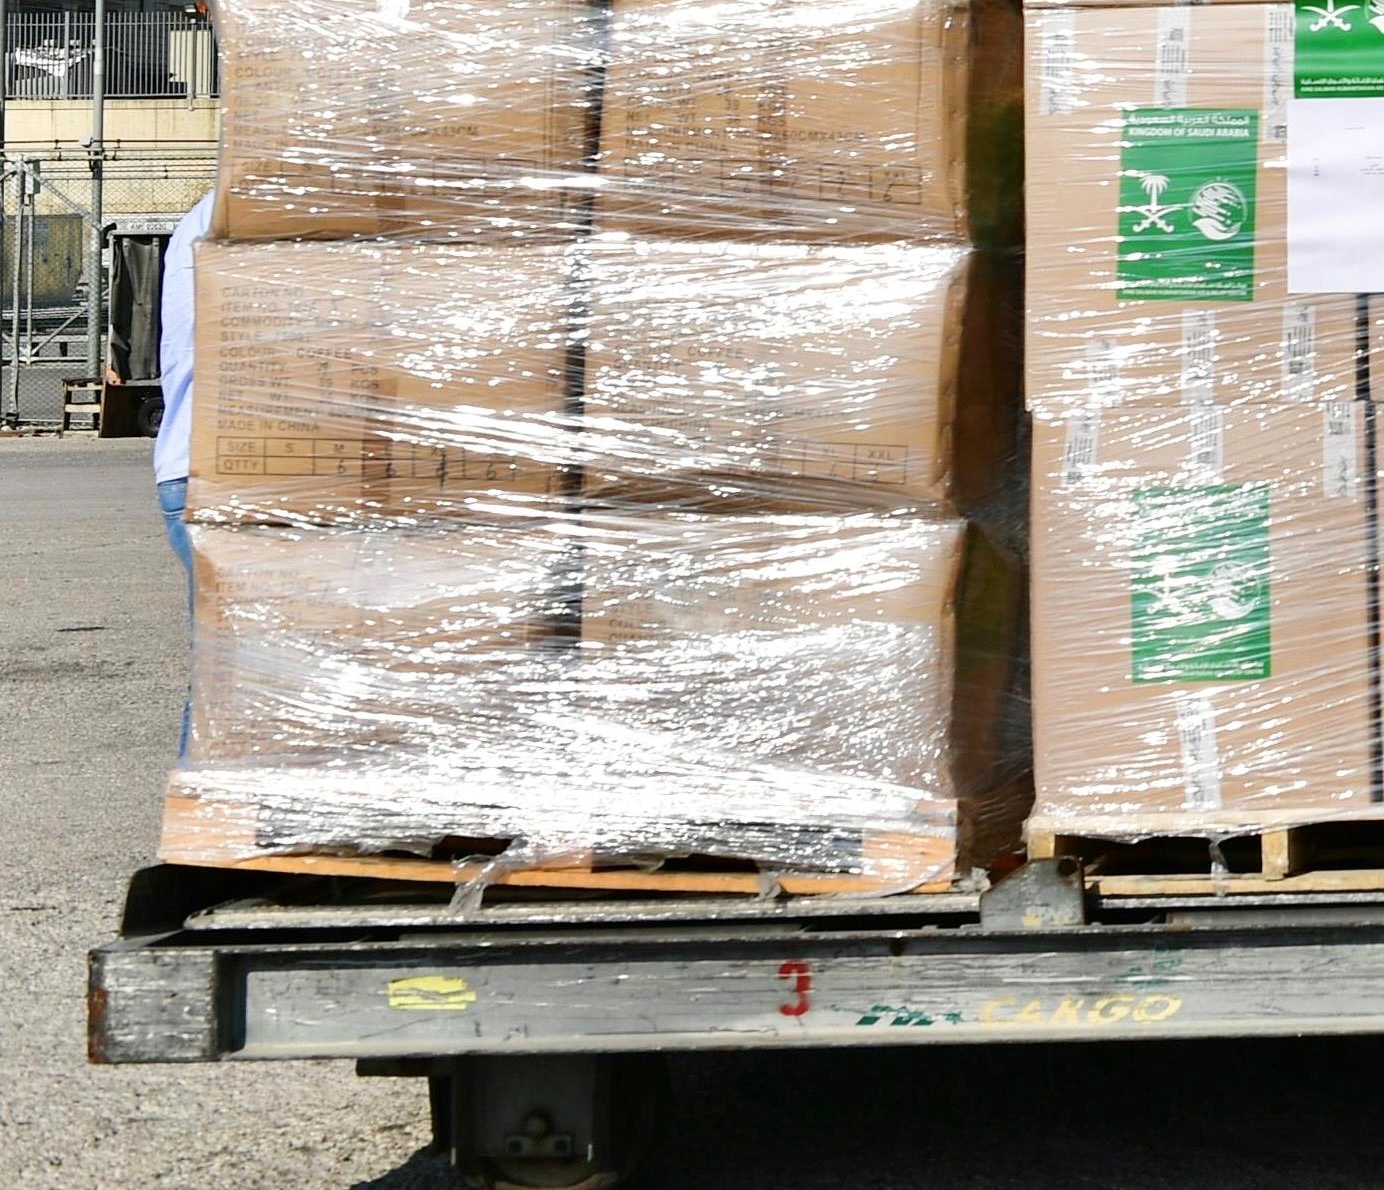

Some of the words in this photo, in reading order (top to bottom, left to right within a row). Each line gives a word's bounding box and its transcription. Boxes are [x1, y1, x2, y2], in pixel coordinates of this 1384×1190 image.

[1129, 128, 1173, 138] KINGDOM
[1174, 128, 1187, 137] OF
[1186, 128, 1215, 137] SAUDI
[1215, 128, 1250, 137] ARABIA
[217, 421, 256, 432] MADE
[261, 422, 272, 432] IN
[277, 422, 320, 433] CHINA
[227, 441, 256, 453] SIZE
[777, 959, 811, 1016] 3
